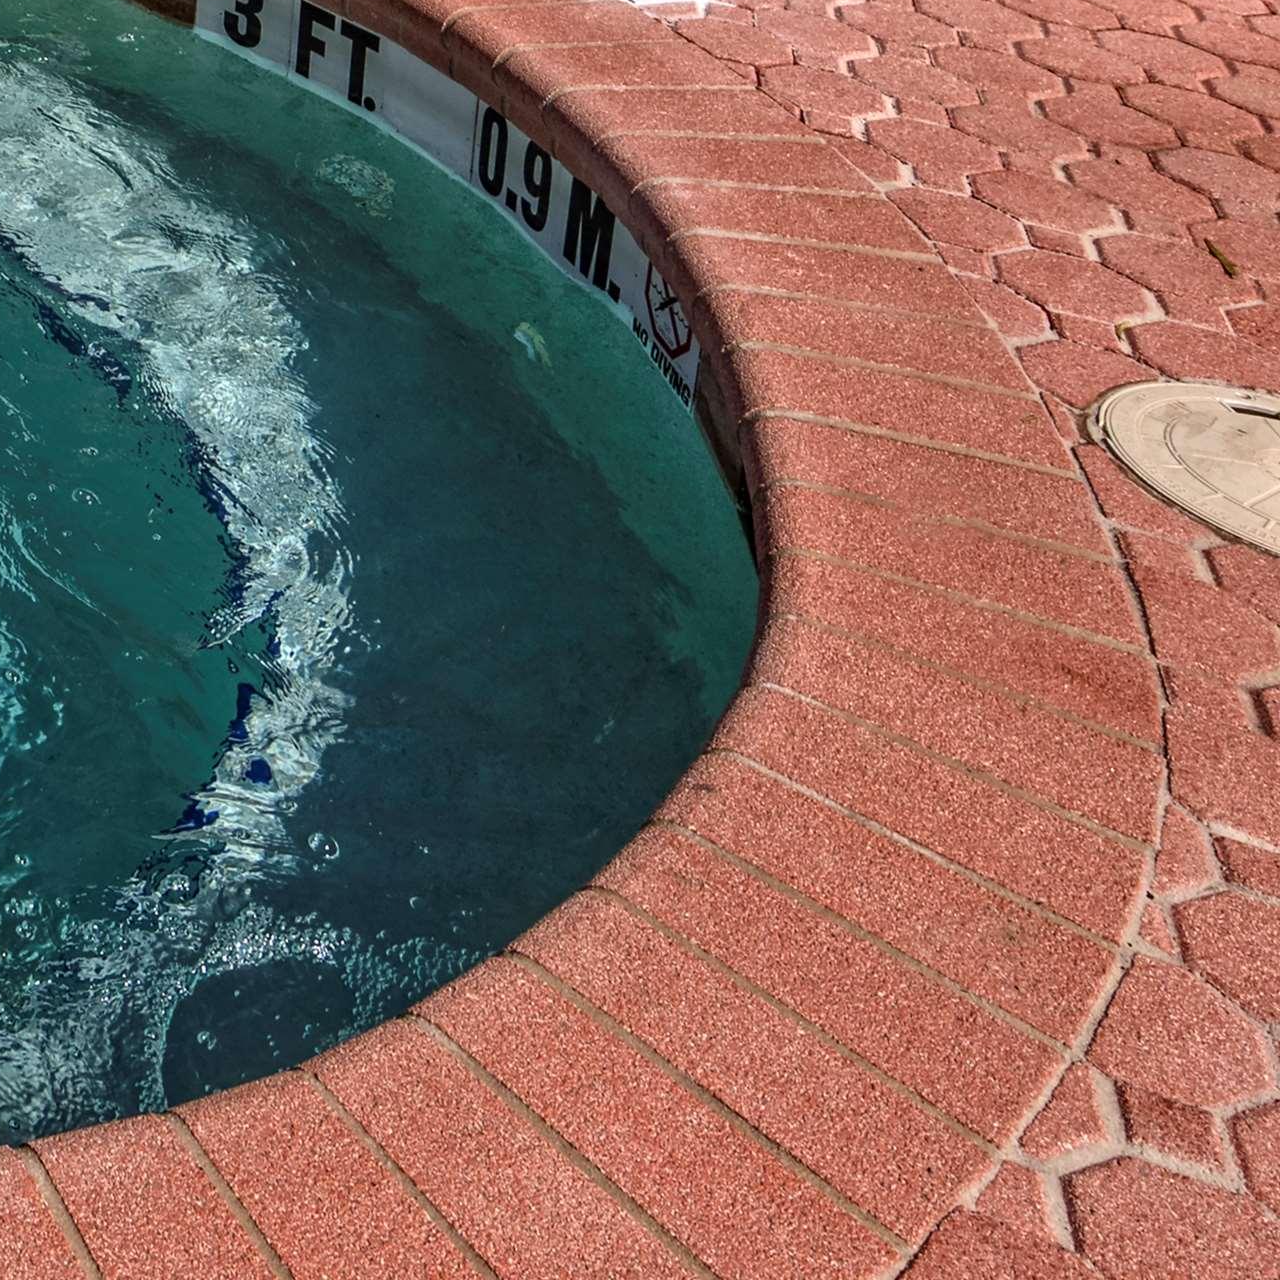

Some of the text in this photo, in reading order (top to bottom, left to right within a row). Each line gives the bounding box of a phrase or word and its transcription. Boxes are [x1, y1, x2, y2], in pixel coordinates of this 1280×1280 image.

[295, 0, 381, 112] FT.
[478, 106, 621, 303] 0.9 M.
[633, 317, 690, 408] NO DIVING
